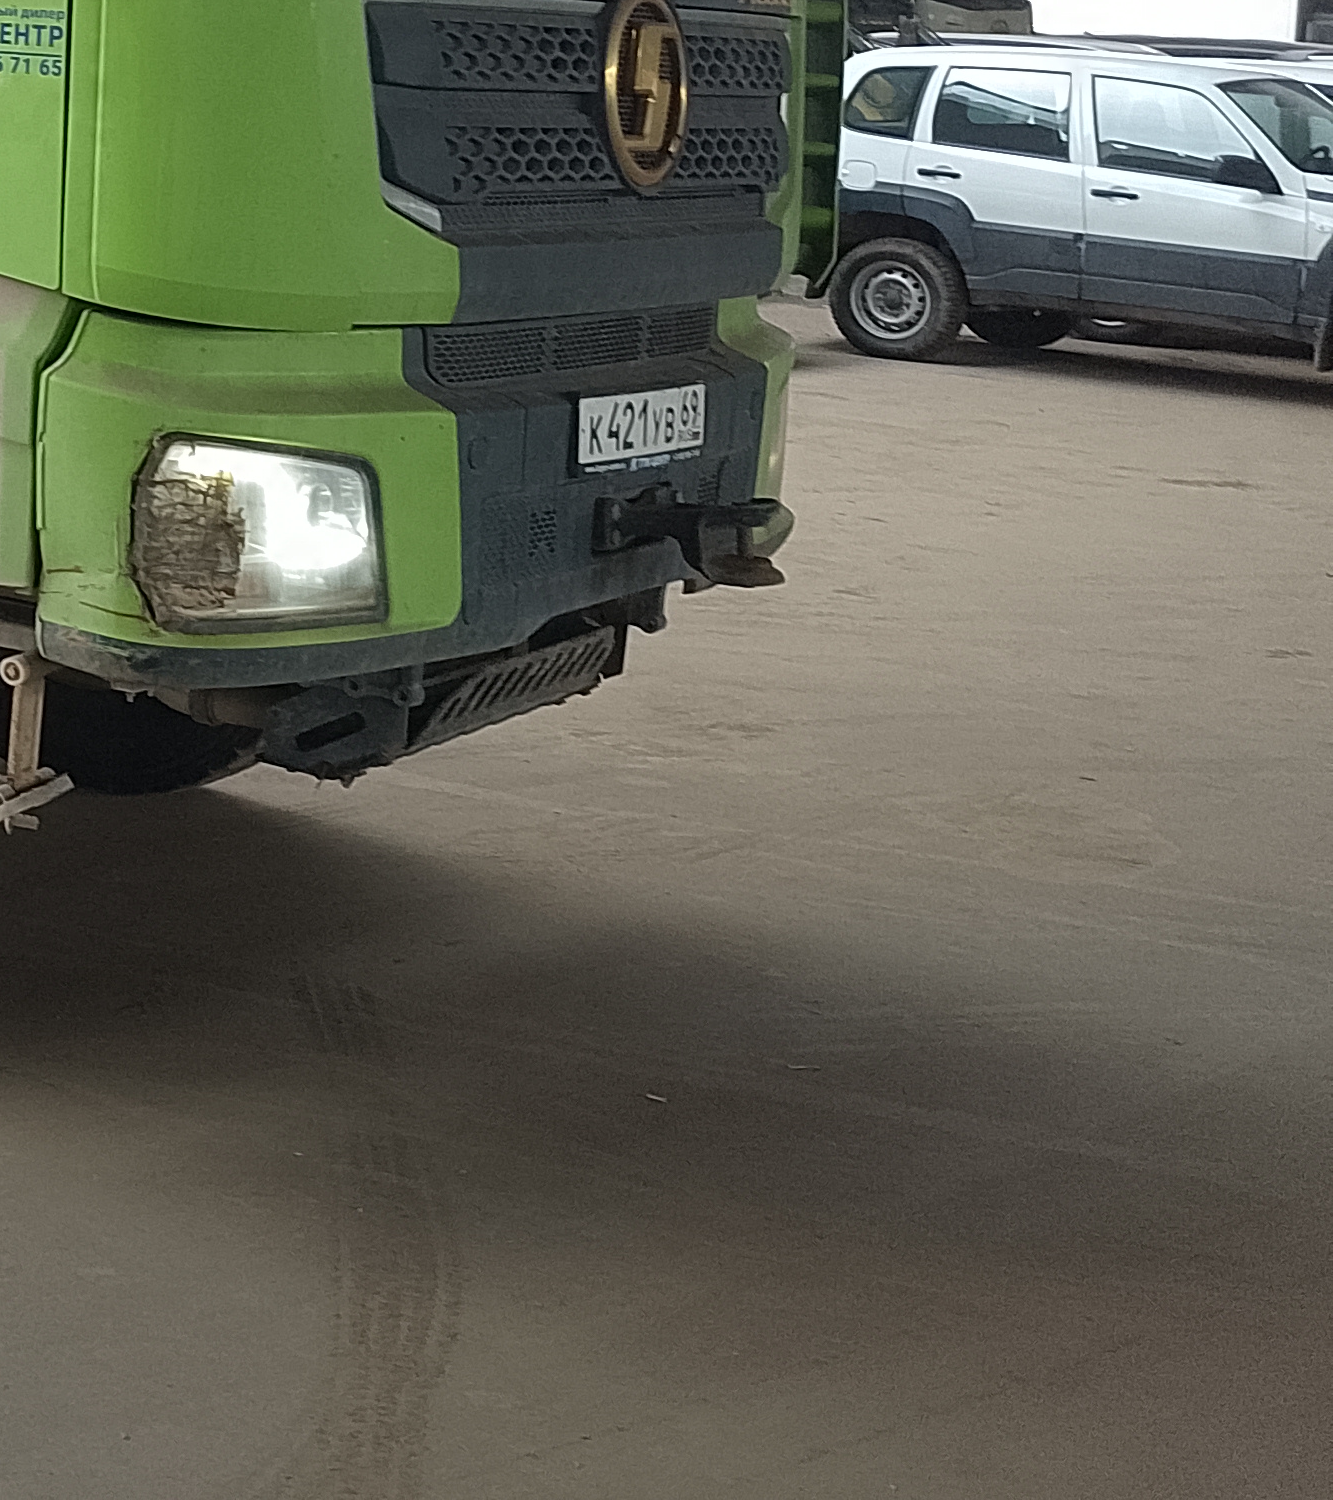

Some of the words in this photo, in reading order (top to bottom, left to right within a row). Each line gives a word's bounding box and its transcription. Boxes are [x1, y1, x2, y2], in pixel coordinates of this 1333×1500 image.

[20, 7, 66, 22] дилер
[9, 56, 31, 75] 71
[38, 59, 63, 77] 65
[588, 398, 676, 455] К421УВ
